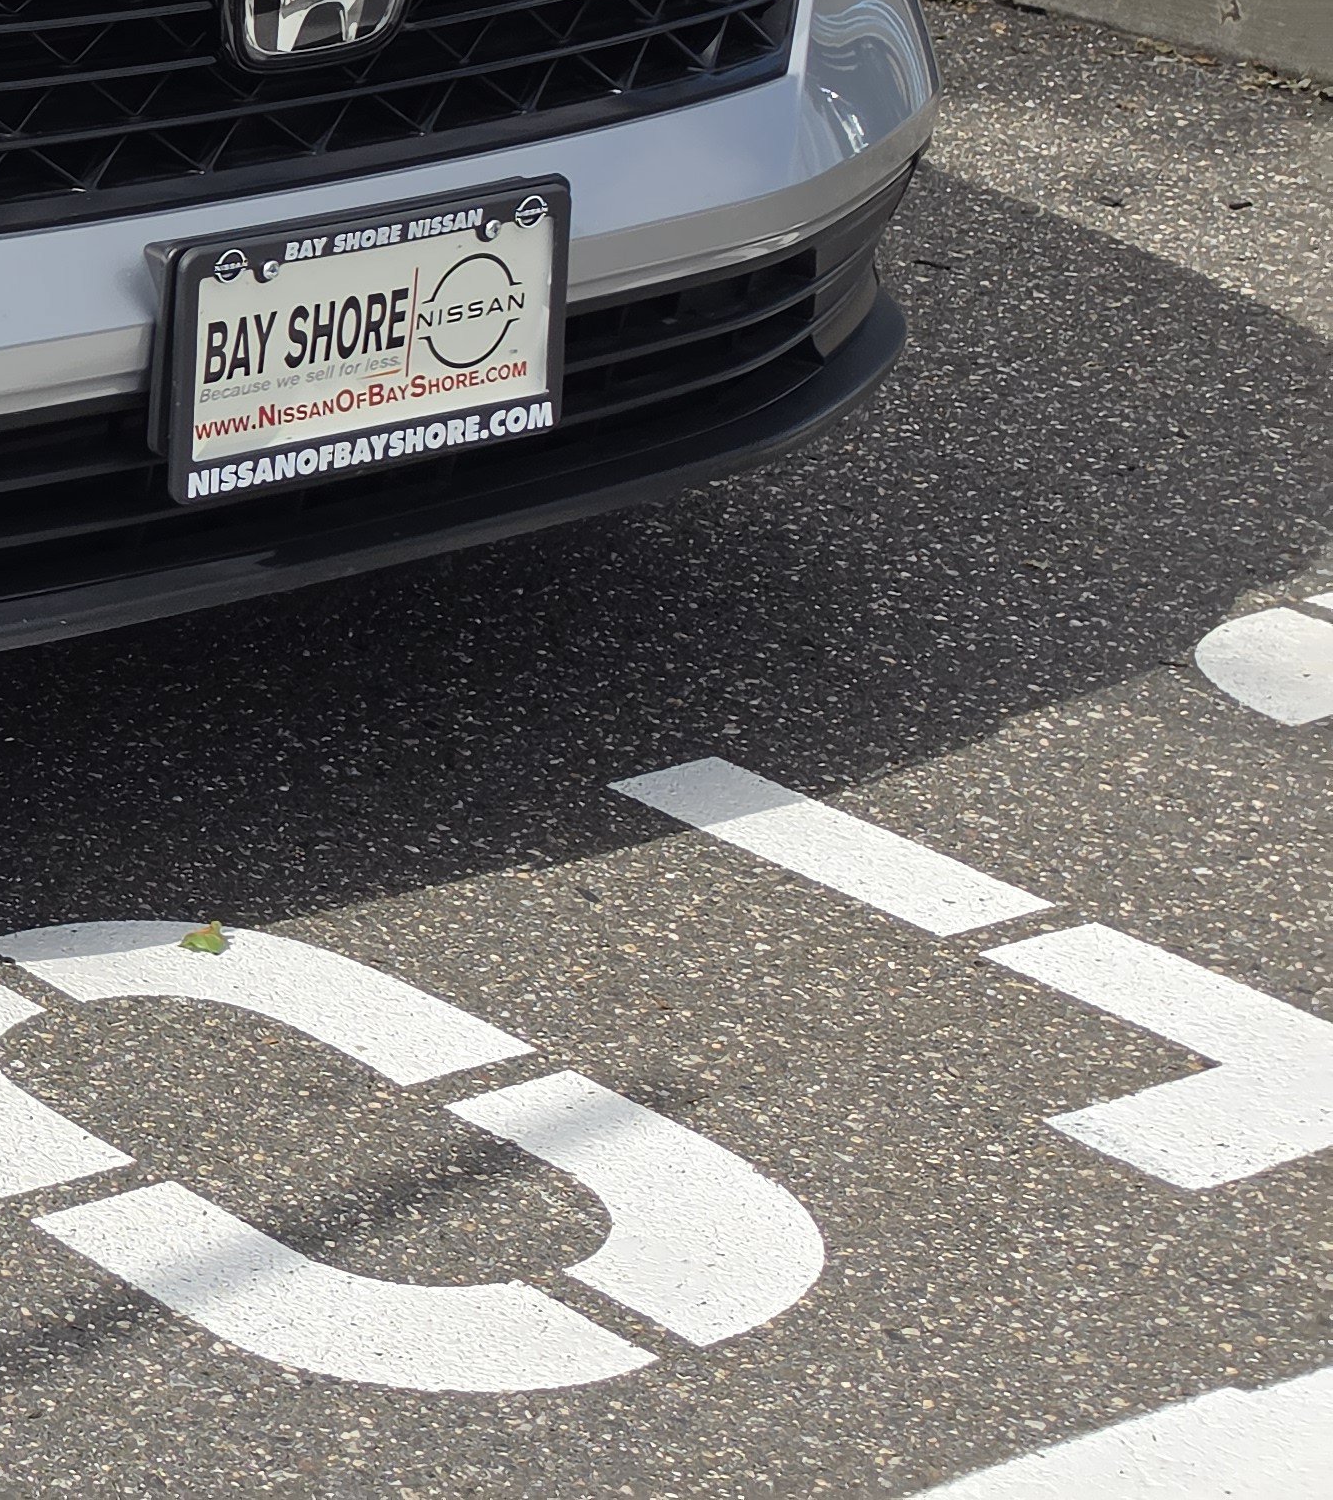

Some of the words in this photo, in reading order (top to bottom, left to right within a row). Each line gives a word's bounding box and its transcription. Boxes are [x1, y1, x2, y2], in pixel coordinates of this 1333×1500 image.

[284, 237, 328, 261] BAY
[332, 223, 402, 253] SHORE
[407, 208, 484, 240] NISSAN
[203, 310, 278, 385] BAY
[284, 287, 410, 368] SHORE
[416, 292, 525, 331] NISSAN
[199, 378, 272, 404] Because
[276, 374, 301, 390] we
[305, 364, 334, 384] sell
[338, 359, 363, 377] for
[187, 401, 554, 499] NISSANOFBAYSHORE.COM
